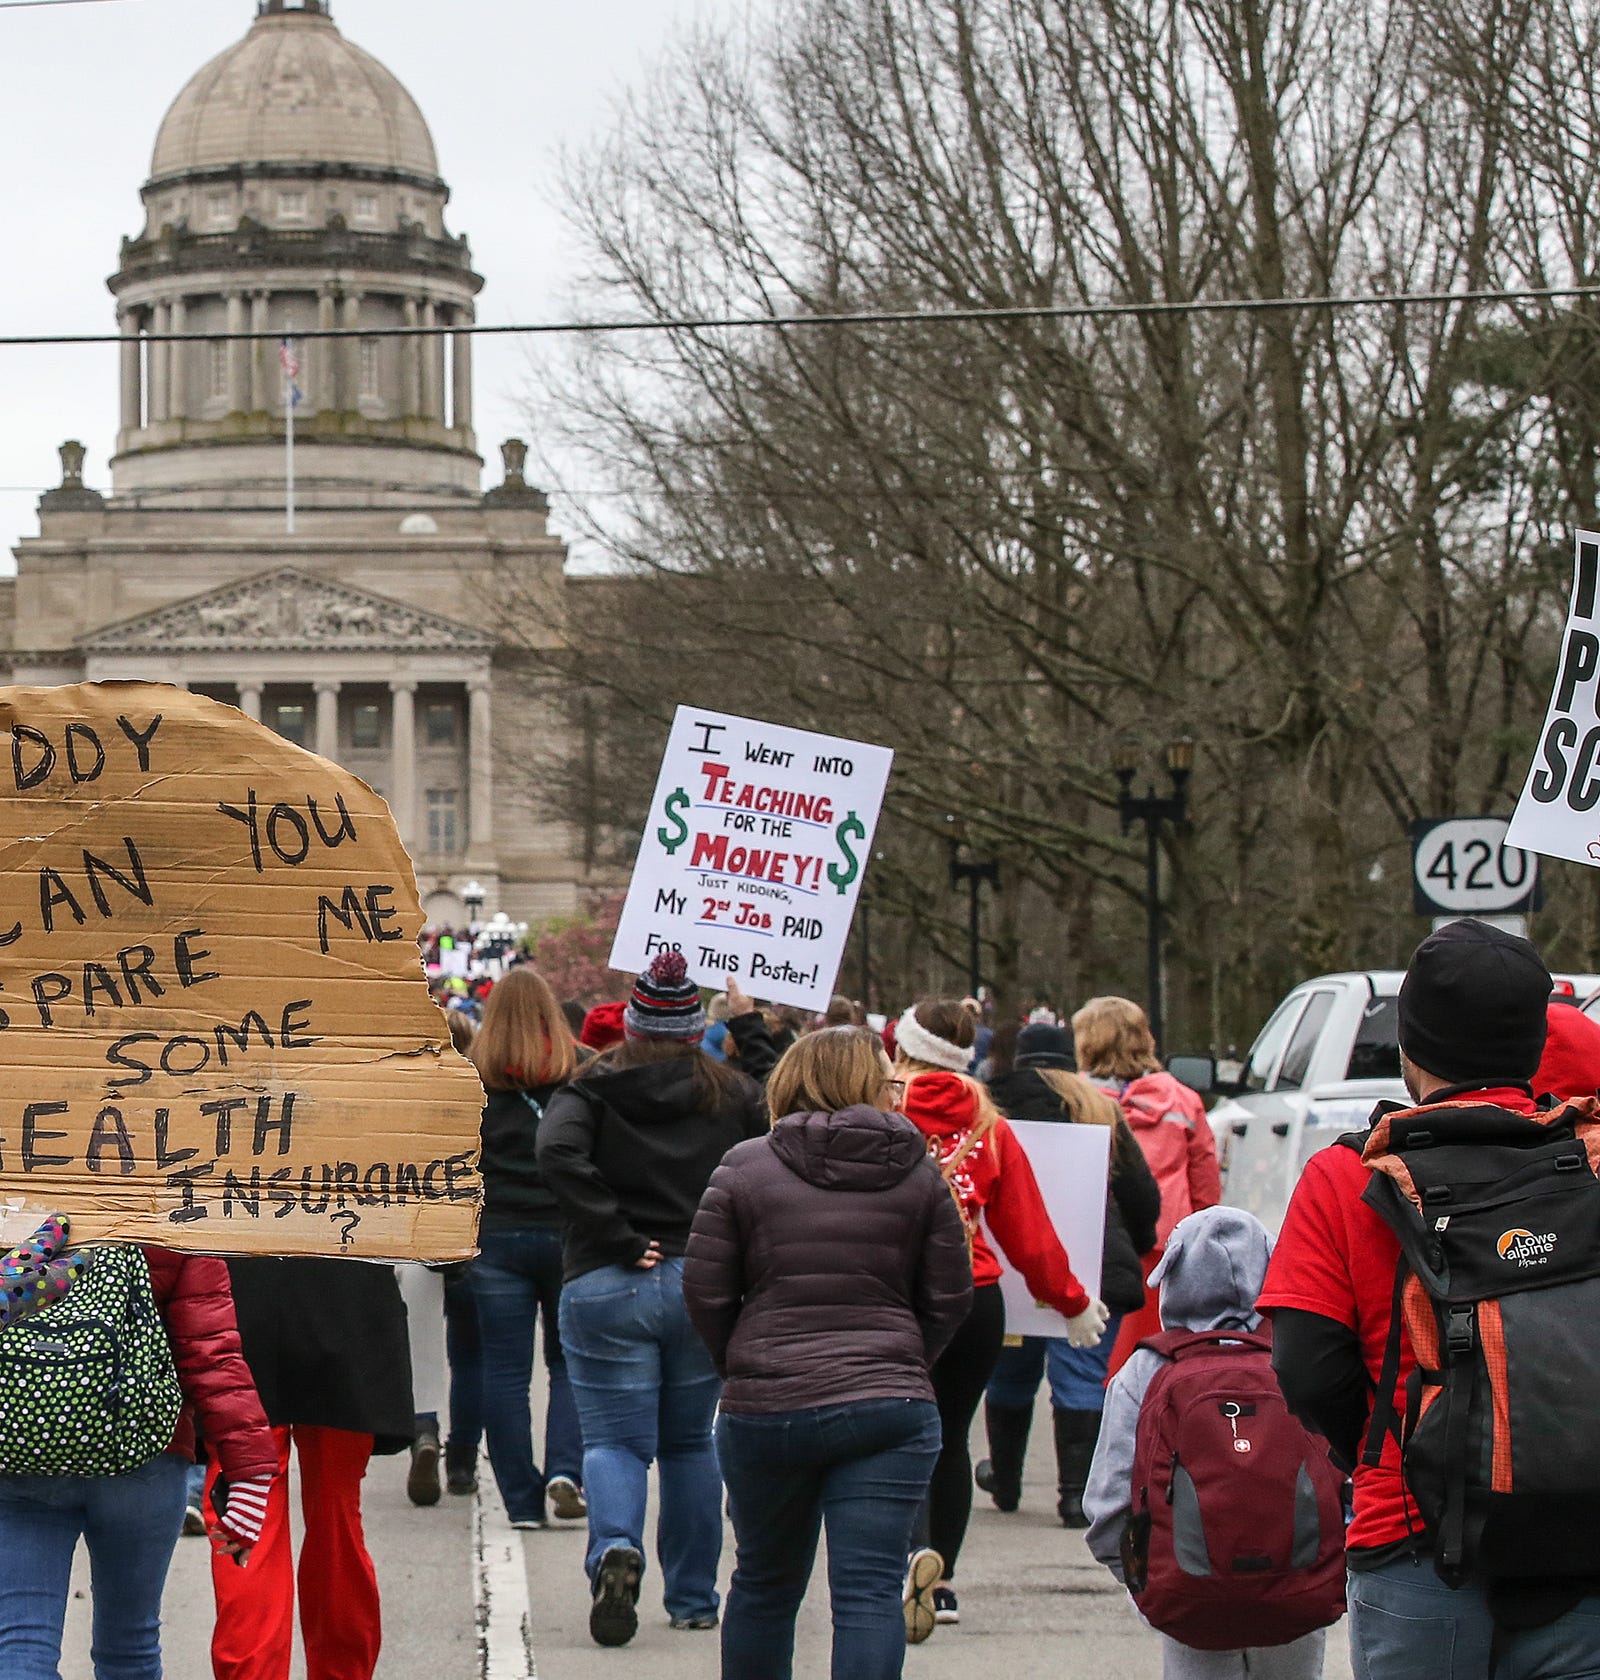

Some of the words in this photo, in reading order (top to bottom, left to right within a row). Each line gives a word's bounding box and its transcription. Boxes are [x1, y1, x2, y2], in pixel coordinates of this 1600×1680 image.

[687, 721, 727, 755] I
[745, 741, 794, 768] WENT
[813, 756, 854, 777] INTO
[701, 761, 835, 824] TEACHING
[217, 788, 357, 873] YOU
[723, 811, 756, 834] FOR
[761, 818, 793, 838] THE
[690, 832, 824, 890] MONEY!
[1426, 838, 1528, 890] 420
[317, 884, 404, 955] ME
[782, 915, 823, 940] PAID
[698, 945, 739, 973] THIS
[750, 952, 819, 990] Poster!
[106, 999, 324, 1088] SOME
[330, 1210, 364, 1254] ?
[1506, 1242, 1554, 1260] alpine
[1514, 1232, 1557, 1248] Lowe
